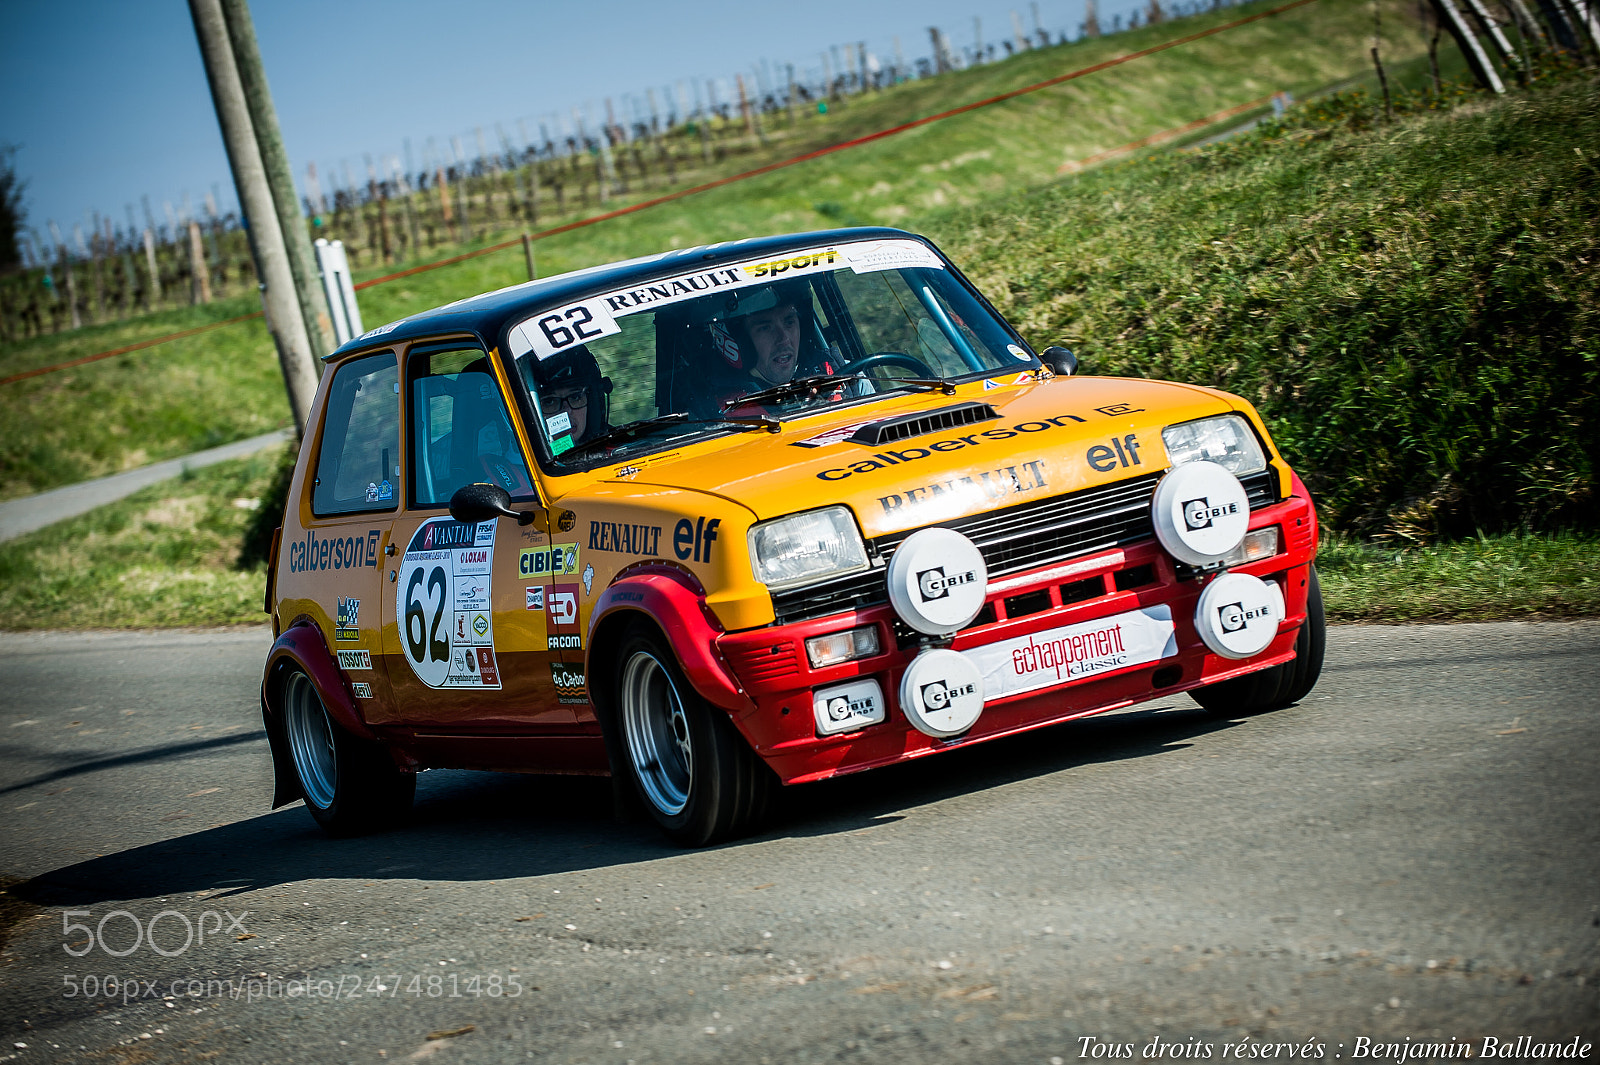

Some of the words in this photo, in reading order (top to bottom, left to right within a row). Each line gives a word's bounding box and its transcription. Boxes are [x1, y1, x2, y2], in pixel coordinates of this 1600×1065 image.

[603, 267, 743, 312] RENAULT
[754, 247, 838, 278] sport
[538, 306, 602, 349] 62
[816, 414, 1087, 481] calberson
[1087, 433, 1142, 472] elf
[291, 531, 364, 573] calberson
[424, 525, 474, 546] AVANTIM
[588, 521, 662, 557] RENAULT
[673, 516, 722, 563] elf
[520, 548, 563, 575] CIBIÉ
[405, 566, 450, 664] 62
[338, 652, 363, 668] TISSOT
[552, 671, 563, 687] de
[562, 671, 585, 687] Carbo
[1070, 654, 1127, 675] classic
